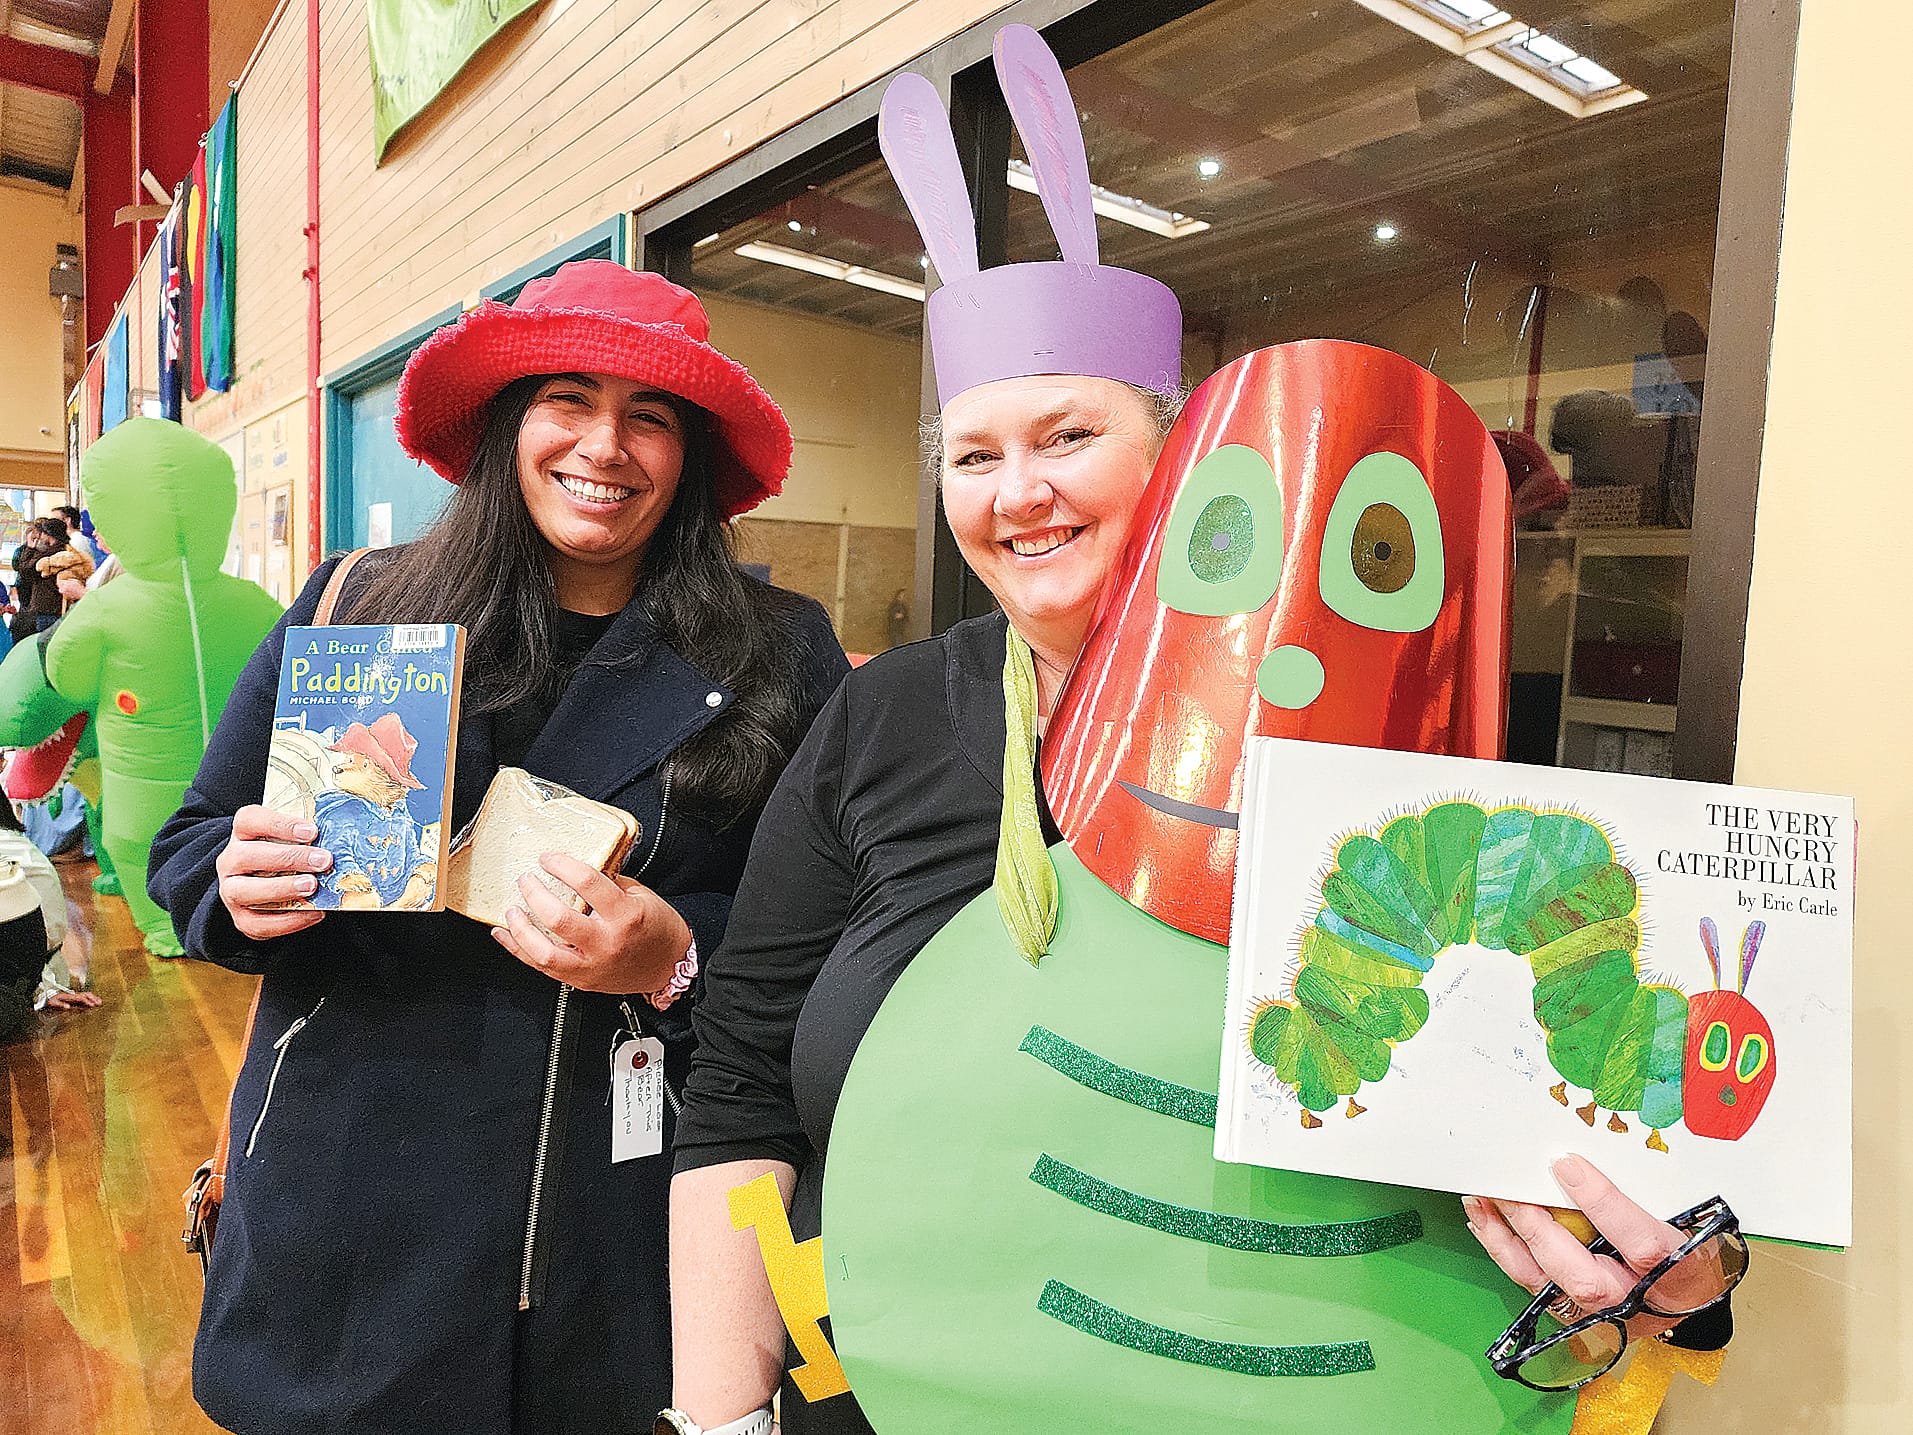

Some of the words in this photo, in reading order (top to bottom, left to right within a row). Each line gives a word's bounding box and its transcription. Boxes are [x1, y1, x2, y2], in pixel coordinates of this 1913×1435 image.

[305, 641, 319, 655] A
[326, 640, 369, 655] Bear
[291, 657, 448, 705] Paddington
[289, 696, 338, 705] MICHAEL
[1706, 803, 1759, 830] THE
[1767, 809, 1838, 838] VERY
[1725, 831, 1838, 864] HUNGRY
[1657, 849, 1837, 890] CATERPILLAR
[1738, 890, 1757, 912] by
[1762, 892, 1794, 912] Eric
[1799, 896, 1838, 917] Carle
